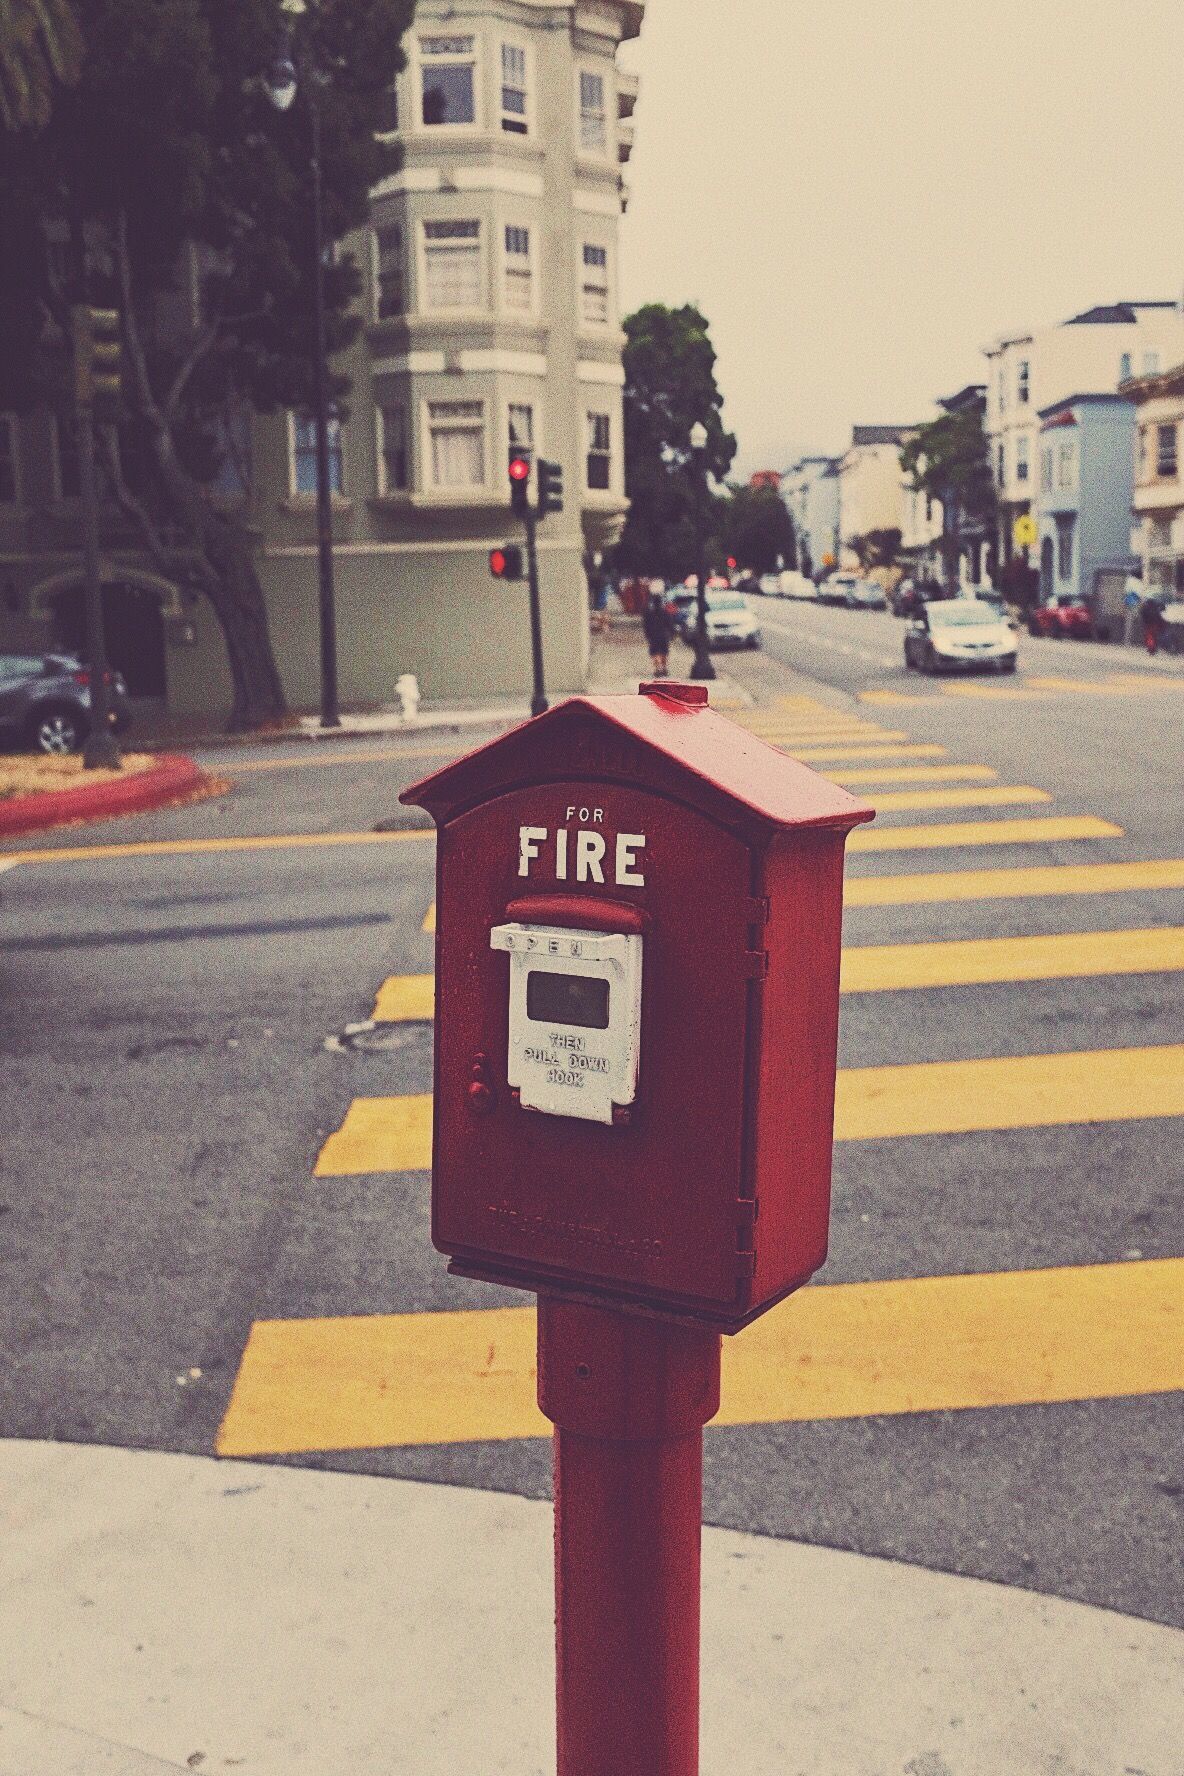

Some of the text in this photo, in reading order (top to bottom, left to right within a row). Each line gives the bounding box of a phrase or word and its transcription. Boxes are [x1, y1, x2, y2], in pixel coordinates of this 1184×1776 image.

[566, 806, 604, 822] FOR
[518, 826, 645, 887] FIRE
[505, 933, 582, 957] OPEN
[549, 1032, 586, 1051] THEN
[524, 1047, 610, 1073] PULL DOWN
[547, 1069, 585, 1087] HOOK
